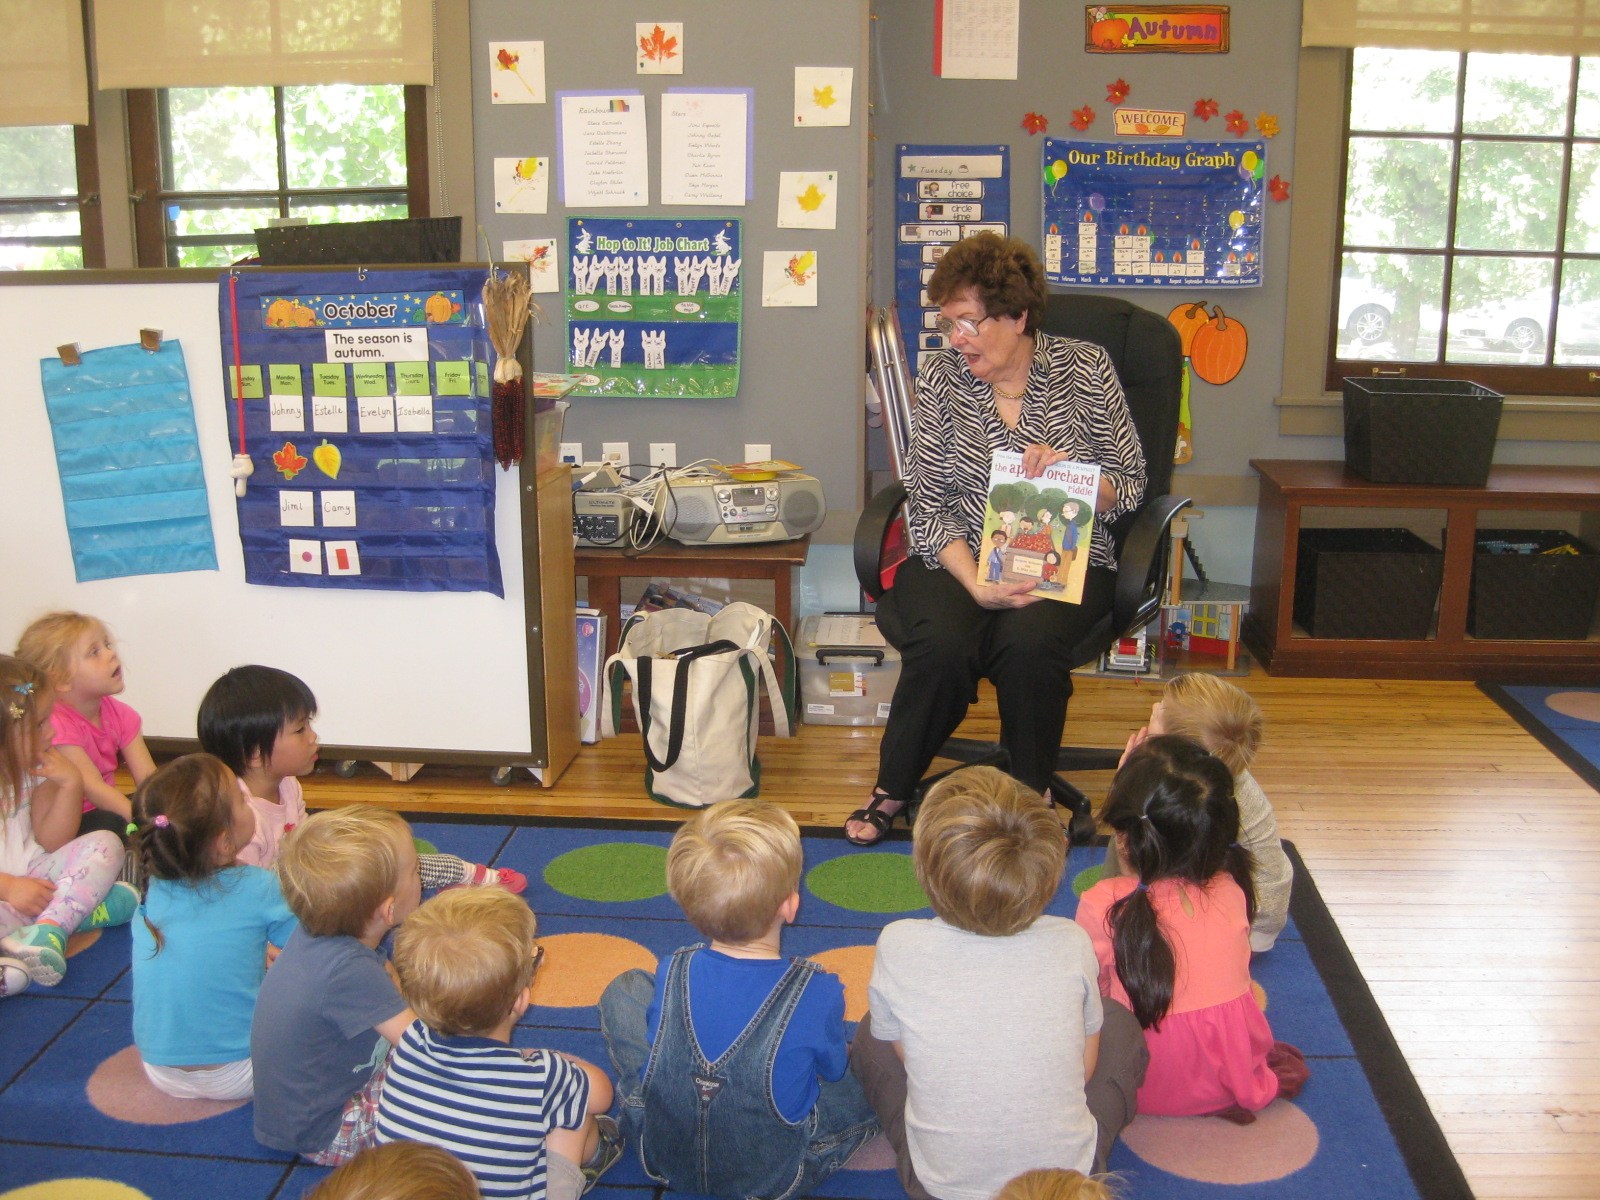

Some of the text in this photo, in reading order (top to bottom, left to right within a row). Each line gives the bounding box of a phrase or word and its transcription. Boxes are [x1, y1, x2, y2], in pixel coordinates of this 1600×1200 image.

[1127, 17, 1218, 40] Autumn
[1121, 113, 1179, 126] WELCOME
[1068, 149, 1236, 170] Our Birthday Graph
[920, 166, 953, 175] Tuesday
[952, 180, 969, 189] free
[948, 190, 973, 198] choice
[951, 204, 973, 213] circle
[953, 212, 971, 221] time
[928, 228, 952, 238] math
[597, 237, 709, 253] Hop to It! Job Chart
[1046, 274, 1060, 282] January
[1061, 275, 1077, 283] February
[1099, 276, 1109, 284] April
[1153, 277, 1162, 285] July
[1184, 278, 1204, 286] September
[1240, 277, 1258, 285] December
[324, 302, 397, 321] October
[333, 333, 413, 345] The season is
[335, 347, 385, 359] autumn.
[271, 403, 302, 418] Johnny
[314, 402, 344, 415] Estelle
[360, 403, 392, 418] Evelyn
[397, 402, 432, 415] Isabella
[995, 463, 1008, 473] the
[1047, 469, 1094, 486] orchard
[1068, 486, 1092, 496] riddle
[282, 501, 303, 513] Jimi
